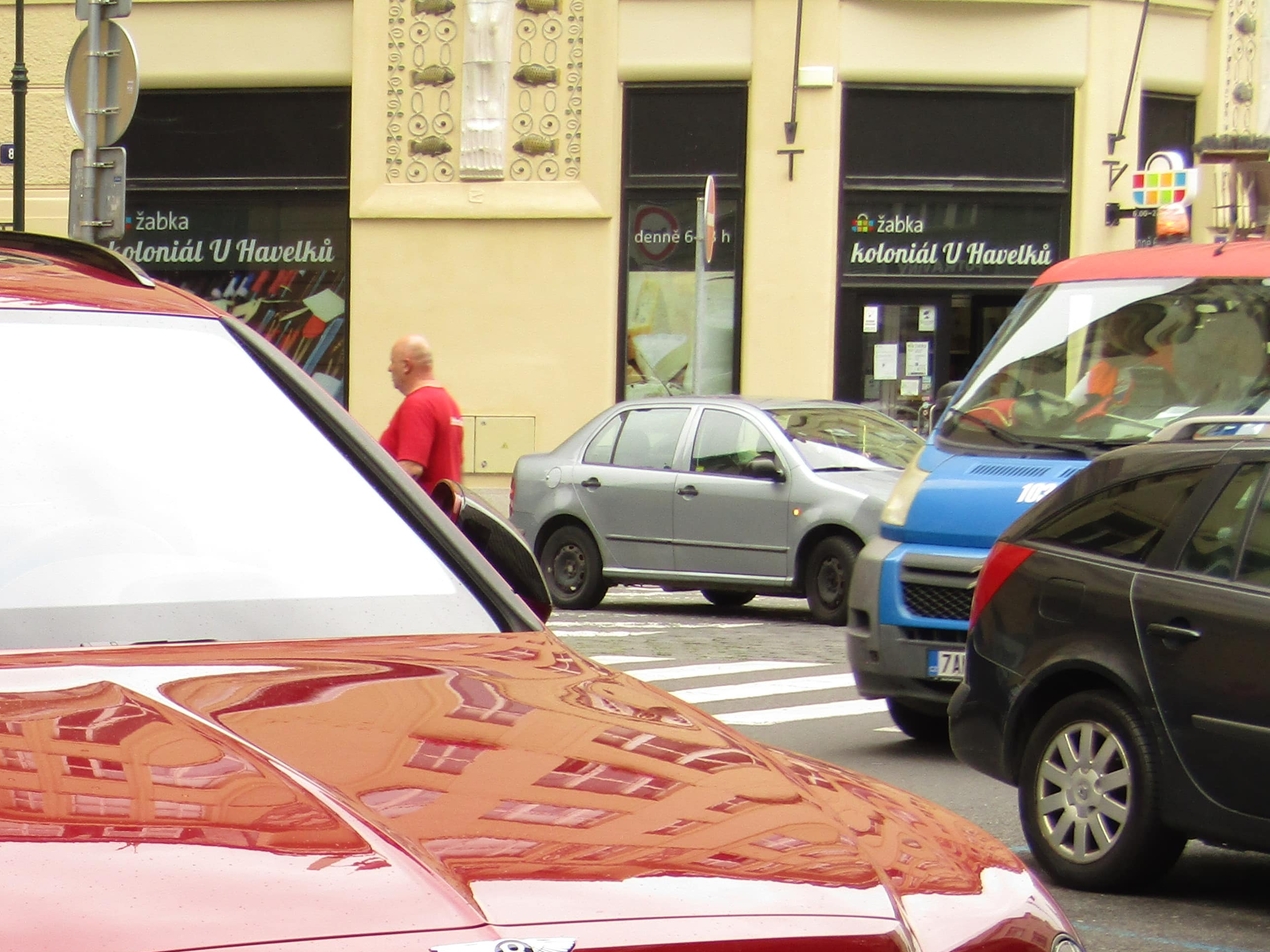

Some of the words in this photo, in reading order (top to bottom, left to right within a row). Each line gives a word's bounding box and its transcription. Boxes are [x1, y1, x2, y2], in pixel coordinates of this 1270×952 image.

[8, 148, 15, 160] 8
[136, 211, 189, 231] žabka
[877, 214, 924, 233] žabka
[634, 230, 680, 243] denně
[721, 230, 730, 243] h
[210, 240, 233, 262] U
[236, 238, 334, 263] Havelků
[850, 242, 938, 264] koloniál
[943, 242, 962, 264] U
[967, 243, 1052, 265] Havelků
[942, 653, 965, 674] 7A
